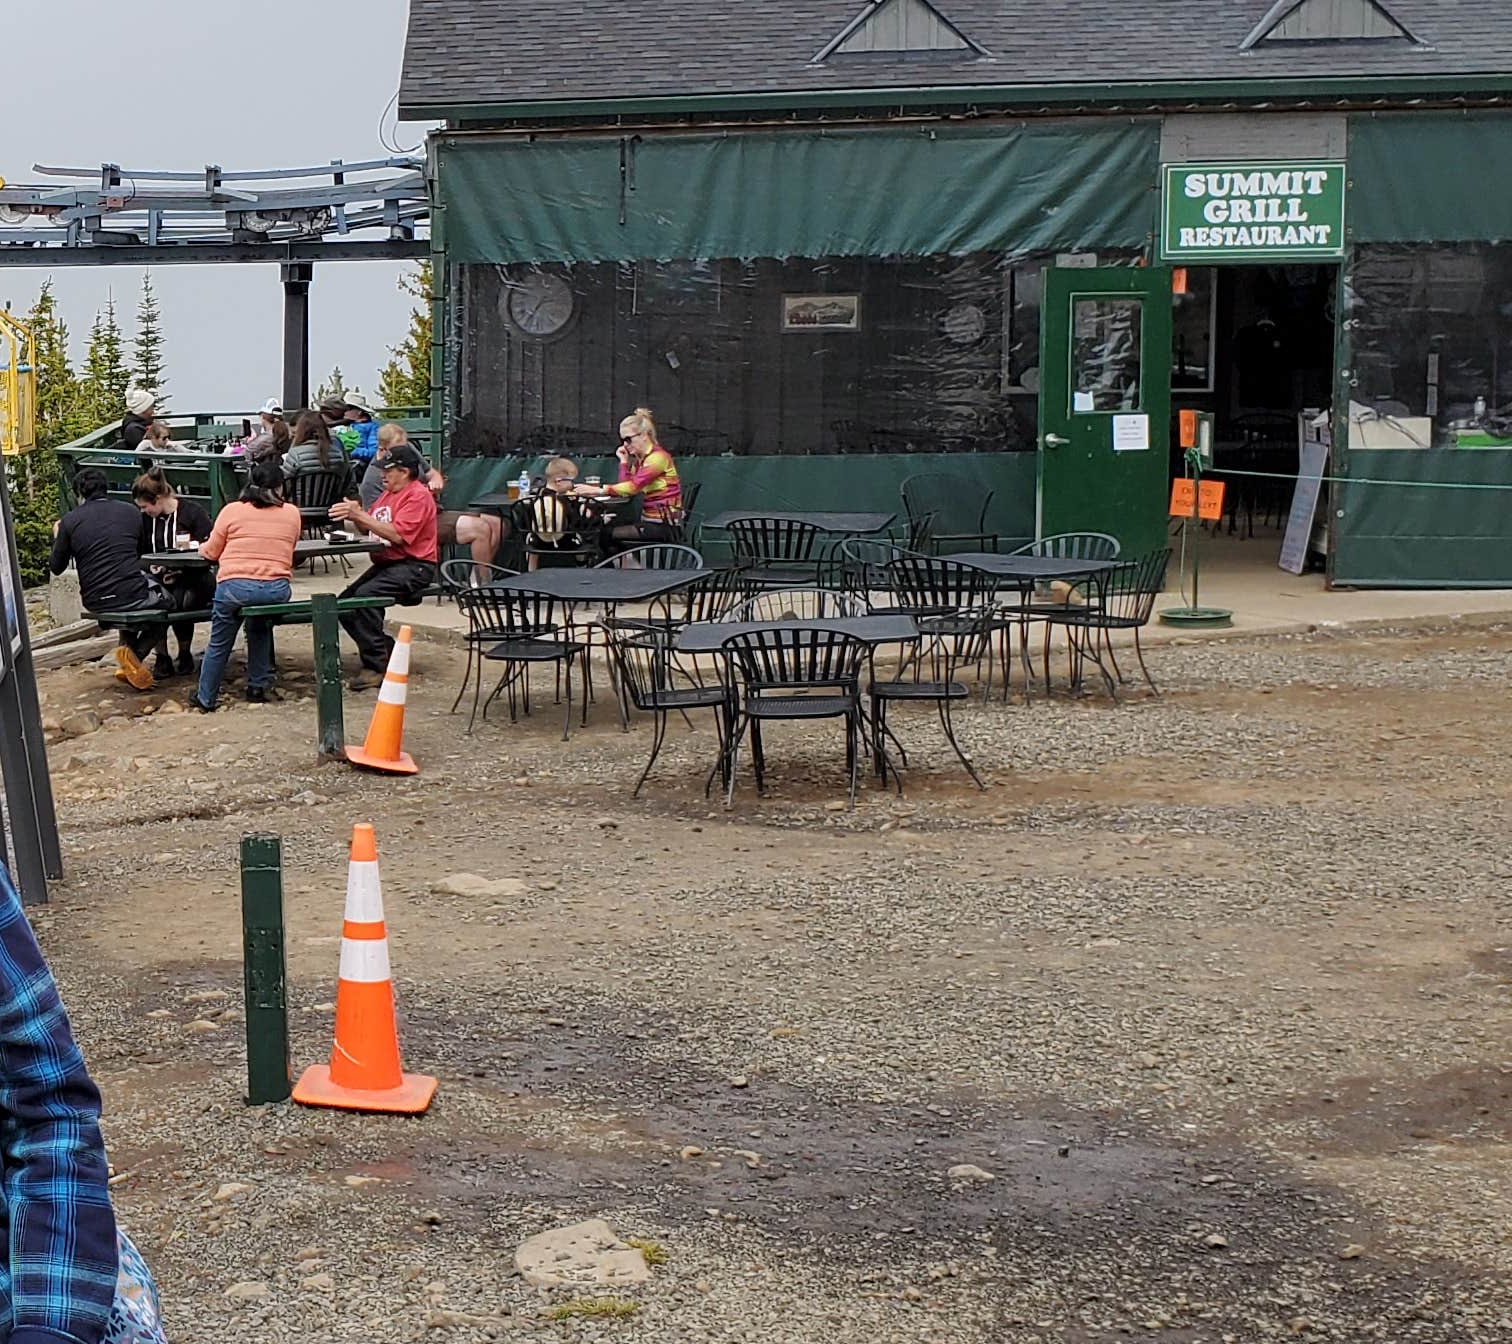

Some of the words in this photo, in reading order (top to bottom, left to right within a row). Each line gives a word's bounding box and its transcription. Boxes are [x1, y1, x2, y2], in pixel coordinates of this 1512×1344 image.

[1184, 171, 1327, 198] SUMMIT
[1203, 198, 1308, 224] GRILL
[1179, 225, 1331, 247] RESTAURANT
